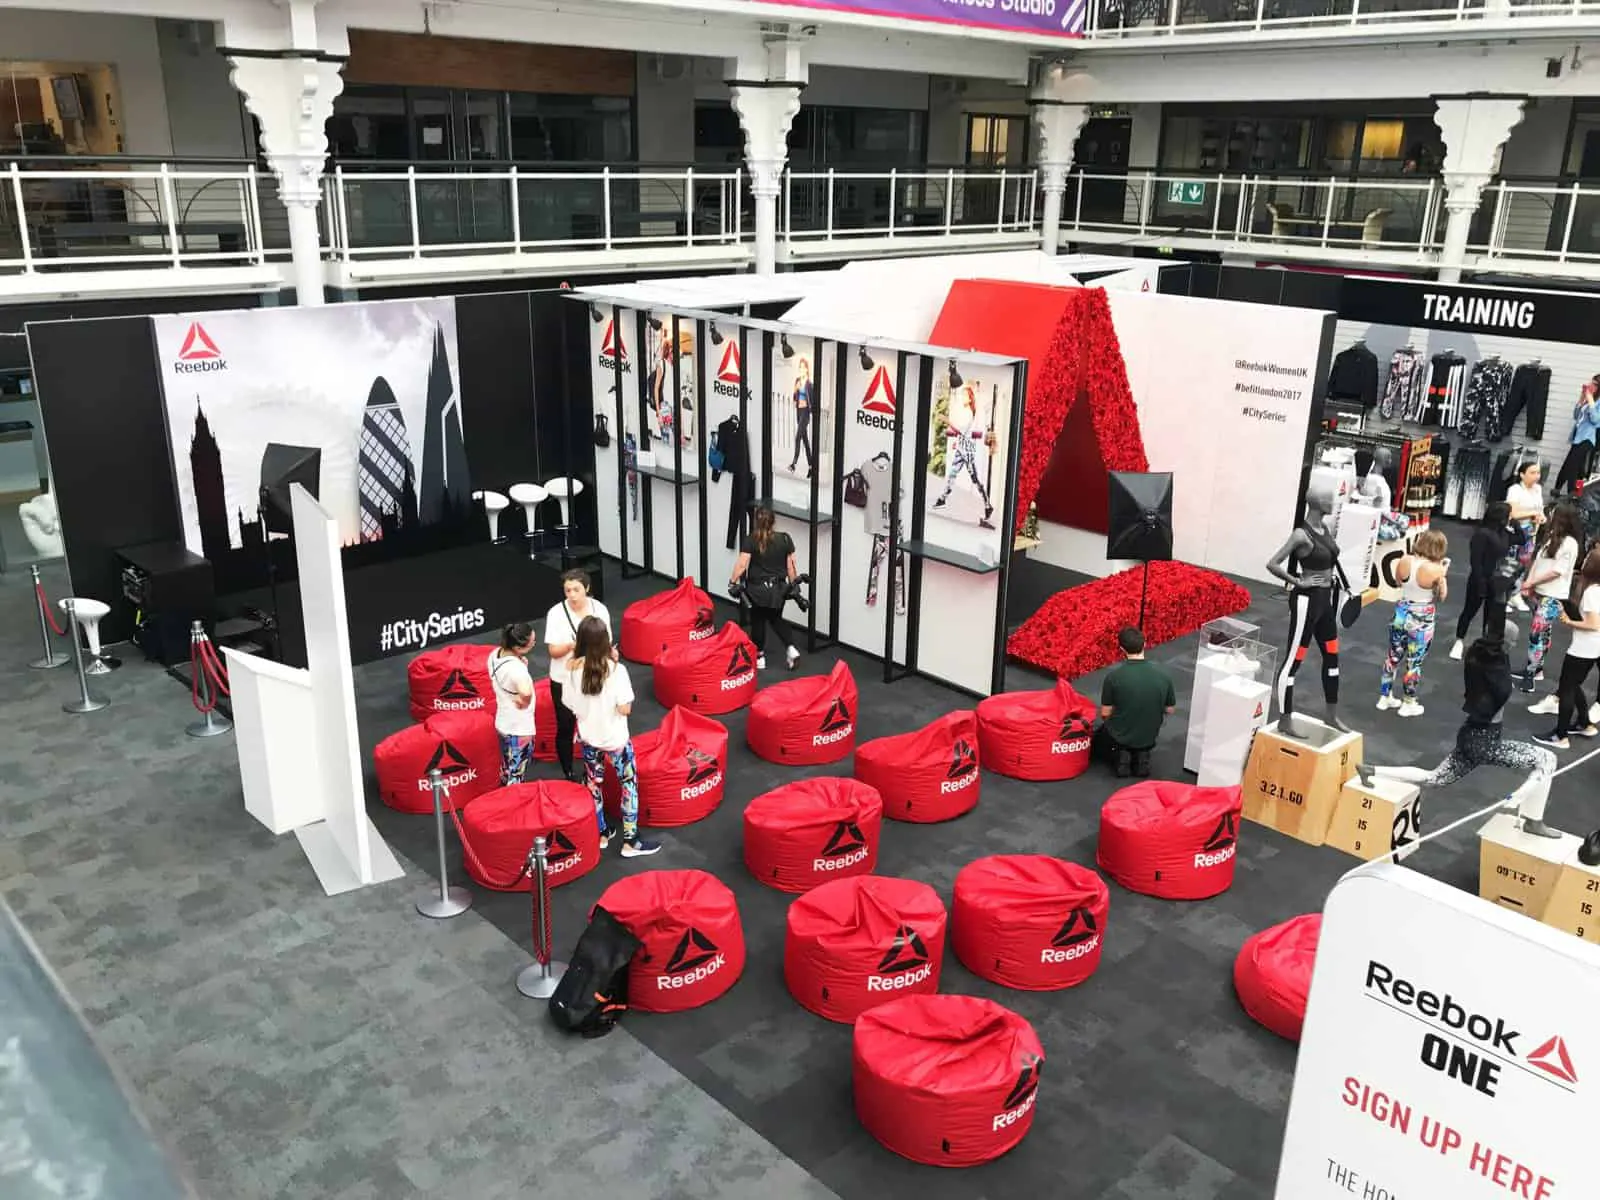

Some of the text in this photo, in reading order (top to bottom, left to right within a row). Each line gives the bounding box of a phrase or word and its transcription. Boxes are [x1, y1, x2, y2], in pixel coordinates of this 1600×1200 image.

[1423, 293, 1535, 329] TRAINING
[174, 359, 228, 374] Reebok
[598, 355, 632, 374] Reeok
[1235, 360, 1308, 377] @ReebokWomenUK
[713, 380, 753, 401] Reebk
[1235, 383, 1302, 400] #befitlondon2017
[856, 410, 904, 434] Reebo
[1242, 407, 1287, 422] #CitySeries
[380, 606, 485, 652] #CitySeries
[433, 697, 486, 711] Reebok
[1361, 797, 1373, 810] 21
[1357, 819, 1367, 831] 15
[1355, 840, 1361, 850] 9
[813, 846, 869, 871] Reebok
[1585, 879, 1600, 893] 21
[1580, 902, 1593, 916] 15
[1040, 935, 1100, 964] Reebok
[656, 952, 726, 991] Reebok
[867, 963, 932, 992] Reebok
[1365, 960, 1520, 1057] Reebok
[1420, 1032, 1502, 1098] ONE
[1341, 1076, 1556, 1200] SIGN UP HERE
[1326, 1157, 1359, 1193] THE
